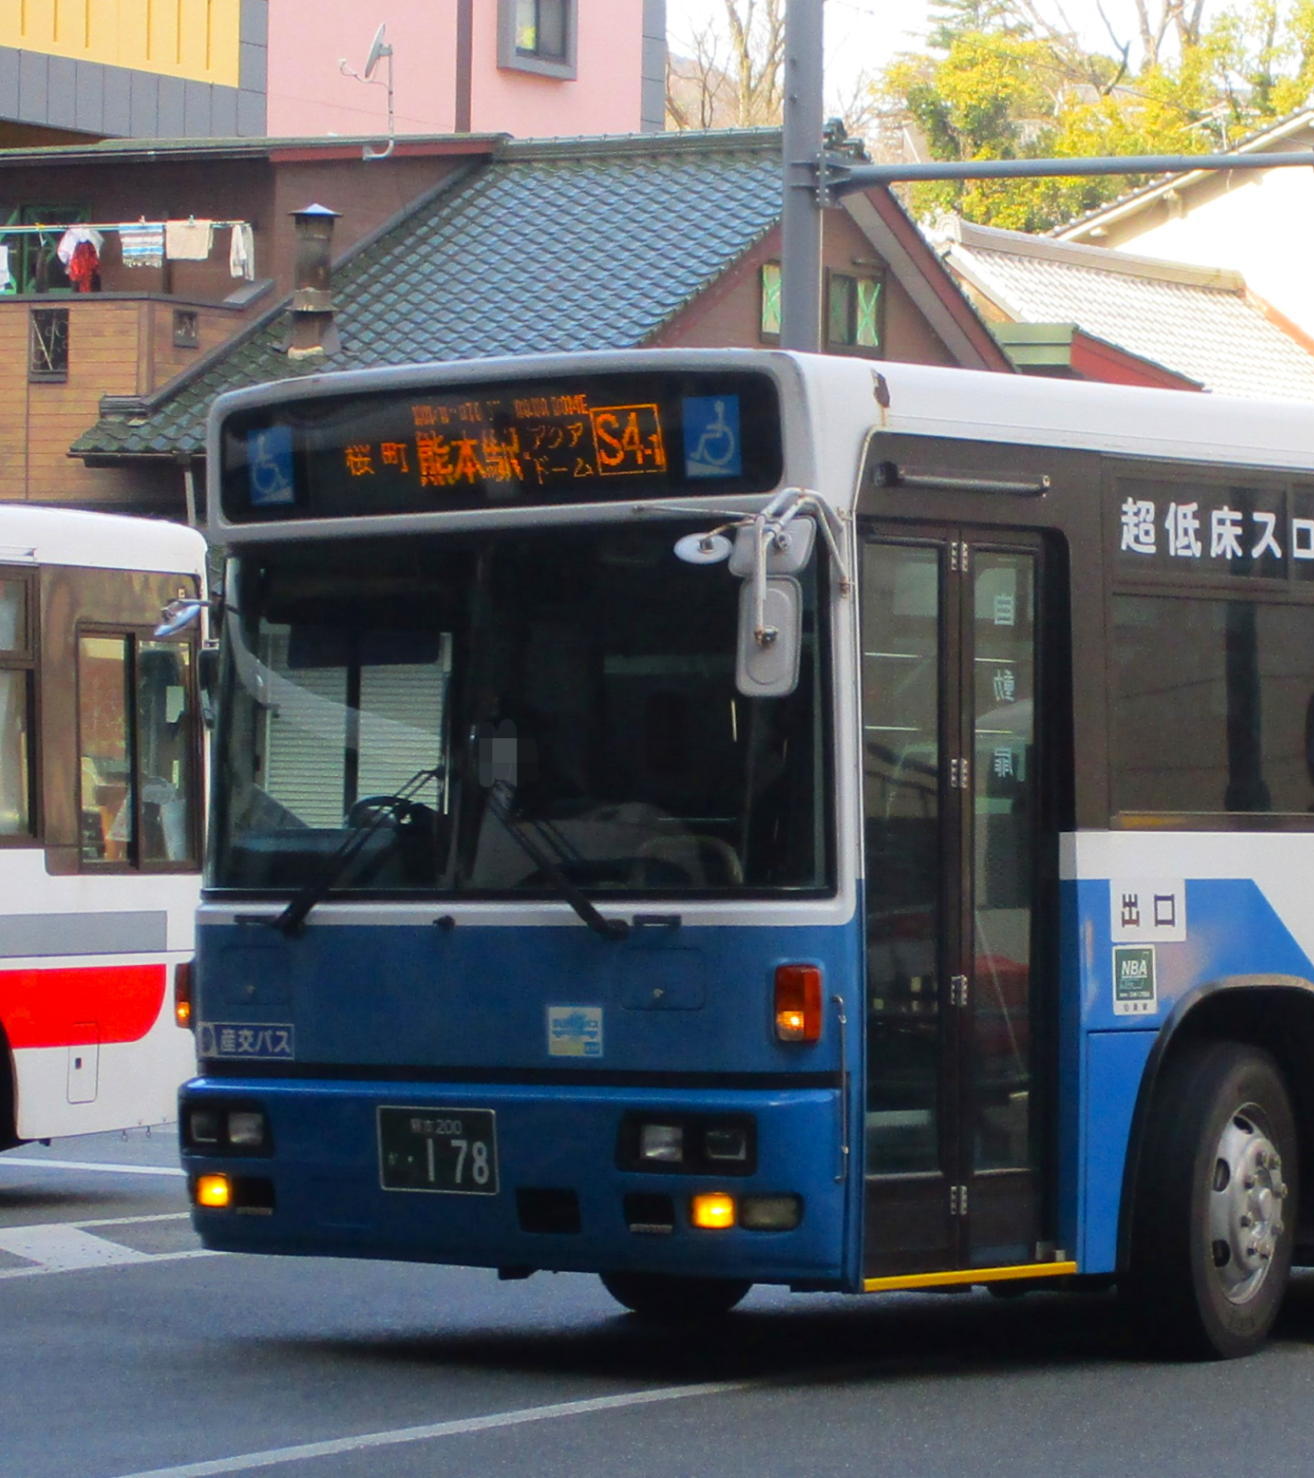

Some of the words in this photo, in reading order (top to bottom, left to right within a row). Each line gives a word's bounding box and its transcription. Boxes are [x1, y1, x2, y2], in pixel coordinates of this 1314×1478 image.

[344, 442, 409, 476] 桜町
[1120, 893, 1176, 929] 出口
[1121, 959, 1149, 977] NBA
[221, 1027, 292, 1054] 産交バス
